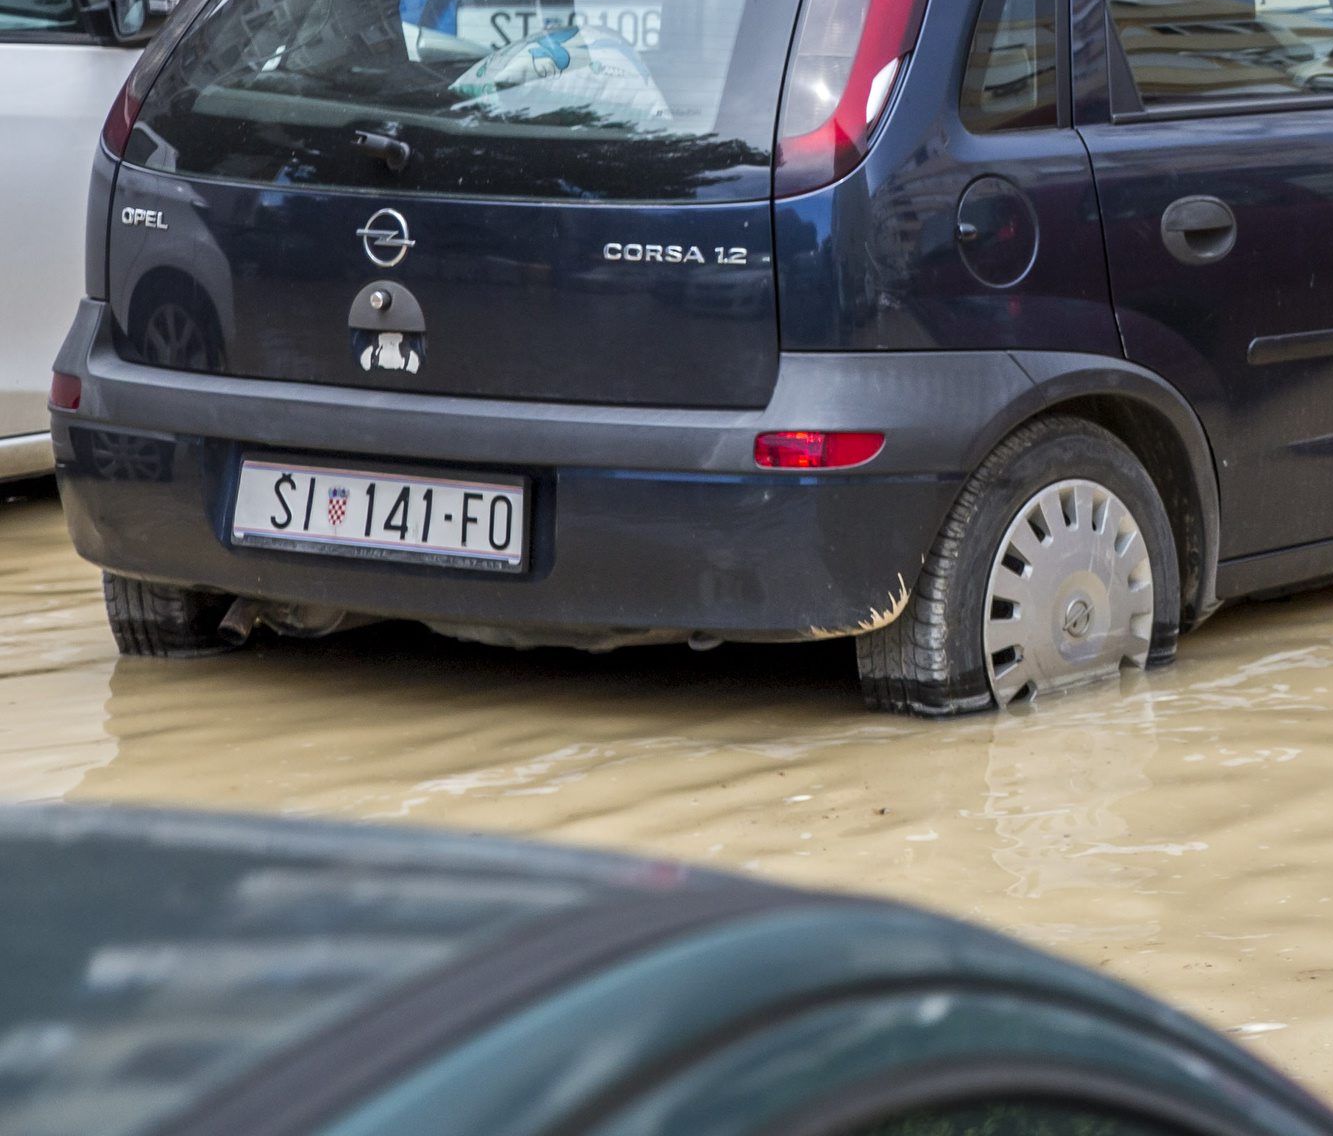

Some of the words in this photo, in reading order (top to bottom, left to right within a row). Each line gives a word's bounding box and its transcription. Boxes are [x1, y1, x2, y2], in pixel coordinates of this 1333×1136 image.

[122, 207, 169, 230] OPEL
[603, 242, 705, 264] CORSA
[714, 246, 748, 265] 1.2
[270, 472, 317, 531] ŠI
[363, 482, 513, 551] 141-FO
